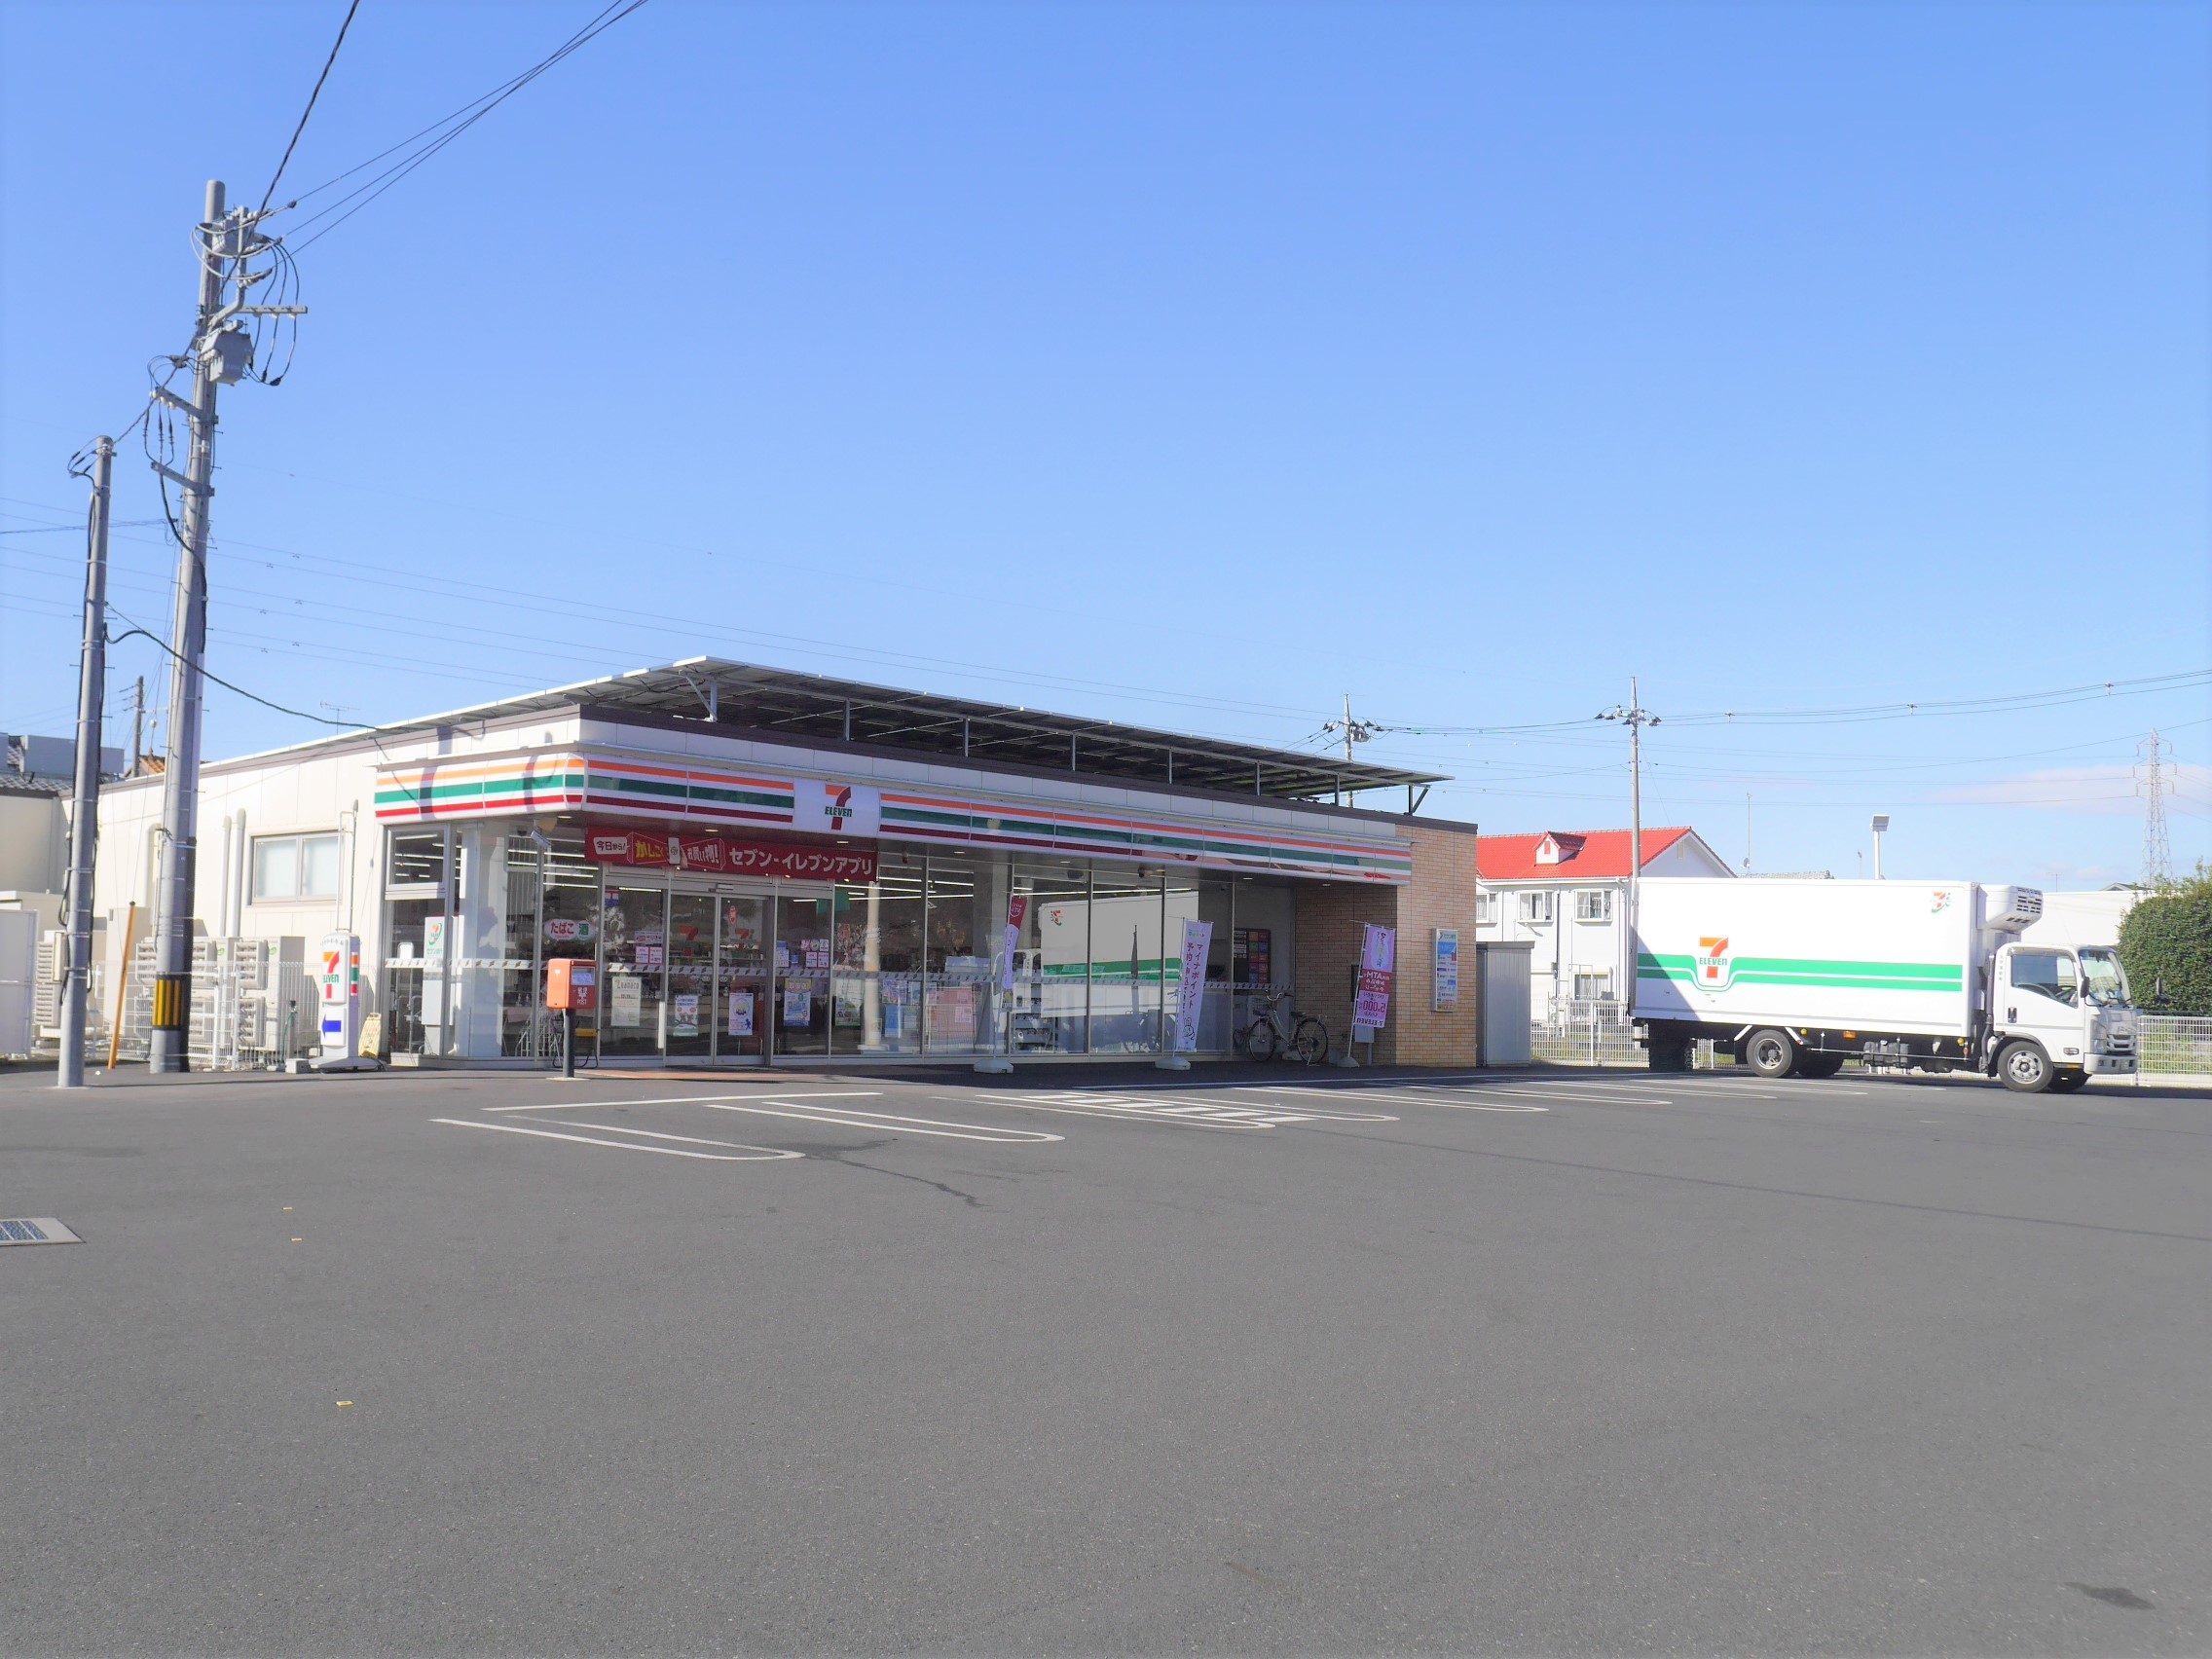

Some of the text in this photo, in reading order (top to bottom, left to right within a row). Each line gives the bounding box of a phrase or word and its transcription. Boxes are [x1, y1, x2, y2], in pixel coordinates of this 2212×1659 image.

[550, 921, 575, 936] たばこ
[1189, 943, 1203, 1009] マイナポイント
